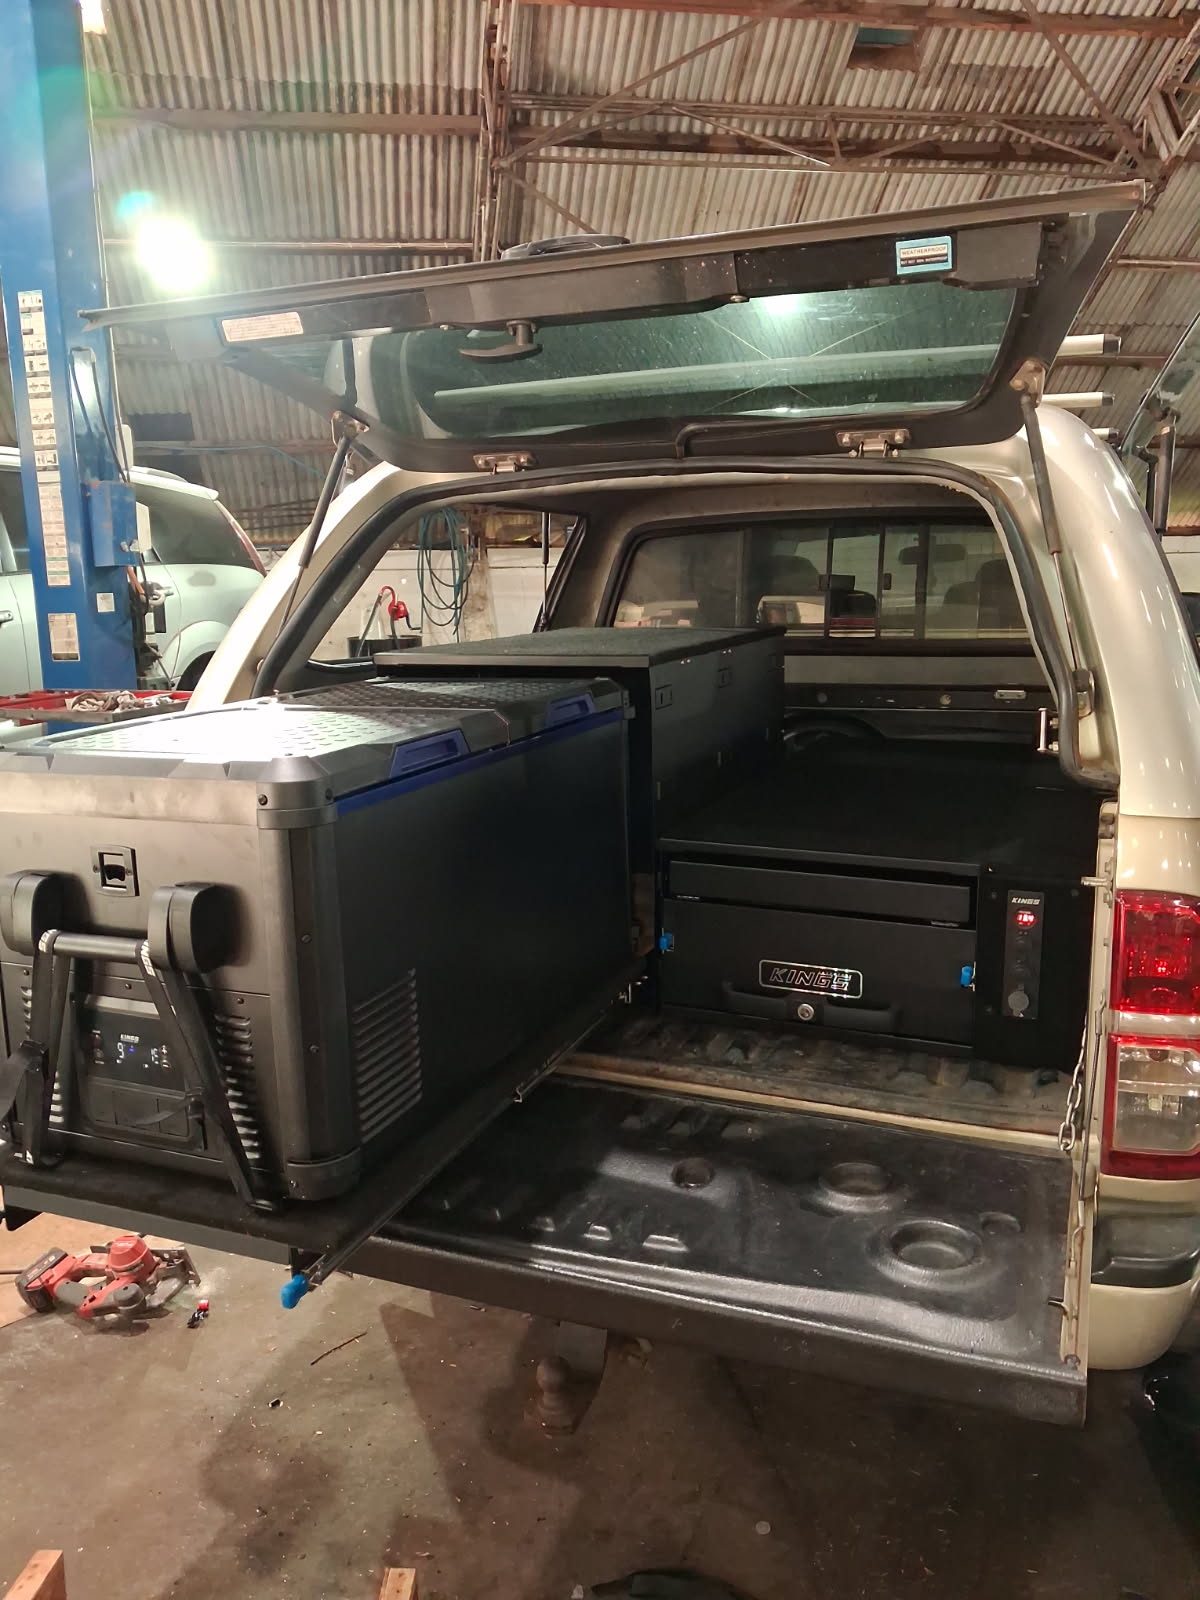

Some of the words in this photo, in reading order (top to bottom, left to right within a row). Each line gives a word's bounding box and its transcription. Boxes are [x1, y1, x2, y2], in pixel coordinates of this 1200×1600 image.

[901, 246, 946, 256] WEATHERPROOF
[1011, 897, 1040, 905] KINGS
[140, 940, 156, 977] INGS
[768, 967, 852, 991] KINGS
